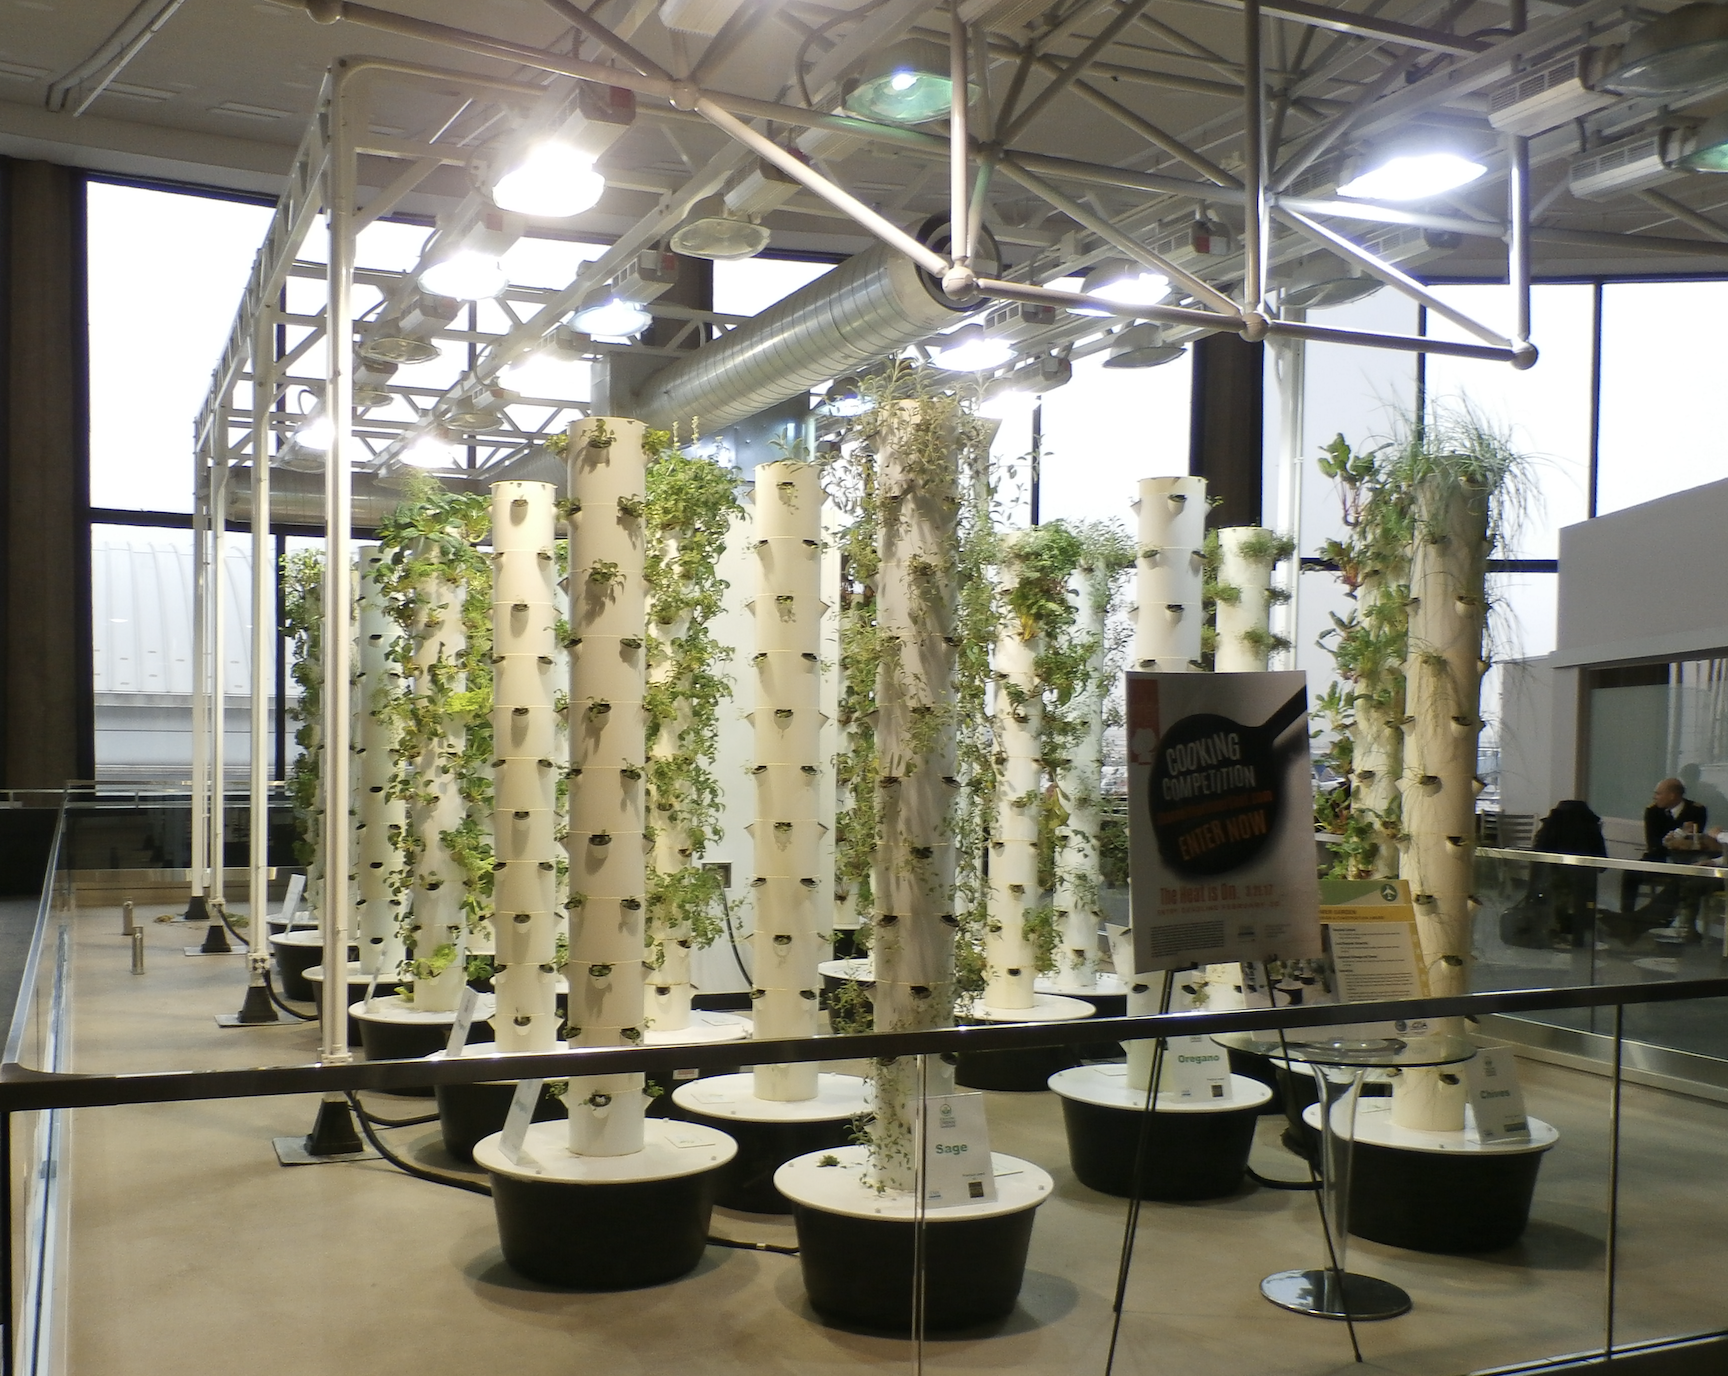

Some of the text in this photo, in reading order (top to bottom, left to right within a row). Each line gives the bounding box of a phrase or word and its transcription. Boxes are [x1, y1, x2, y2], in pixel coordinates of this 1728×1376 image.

[1166, 732, 1241, 776] COOKING
[1162, 764, 1256, 801] COMPETITION
[1178, 809, 1267, 861] ENTER NOW
[1160, 887, 1177, 906] The
[1179, 885, 1205, 904] Heat
[1208, 885, 1218, 902] is
[1178, 1055, 1220, 1064] Oregano
[1480, 1090, 1511, 1099] Chives
[935, 1143, 968, 1156] Sage
